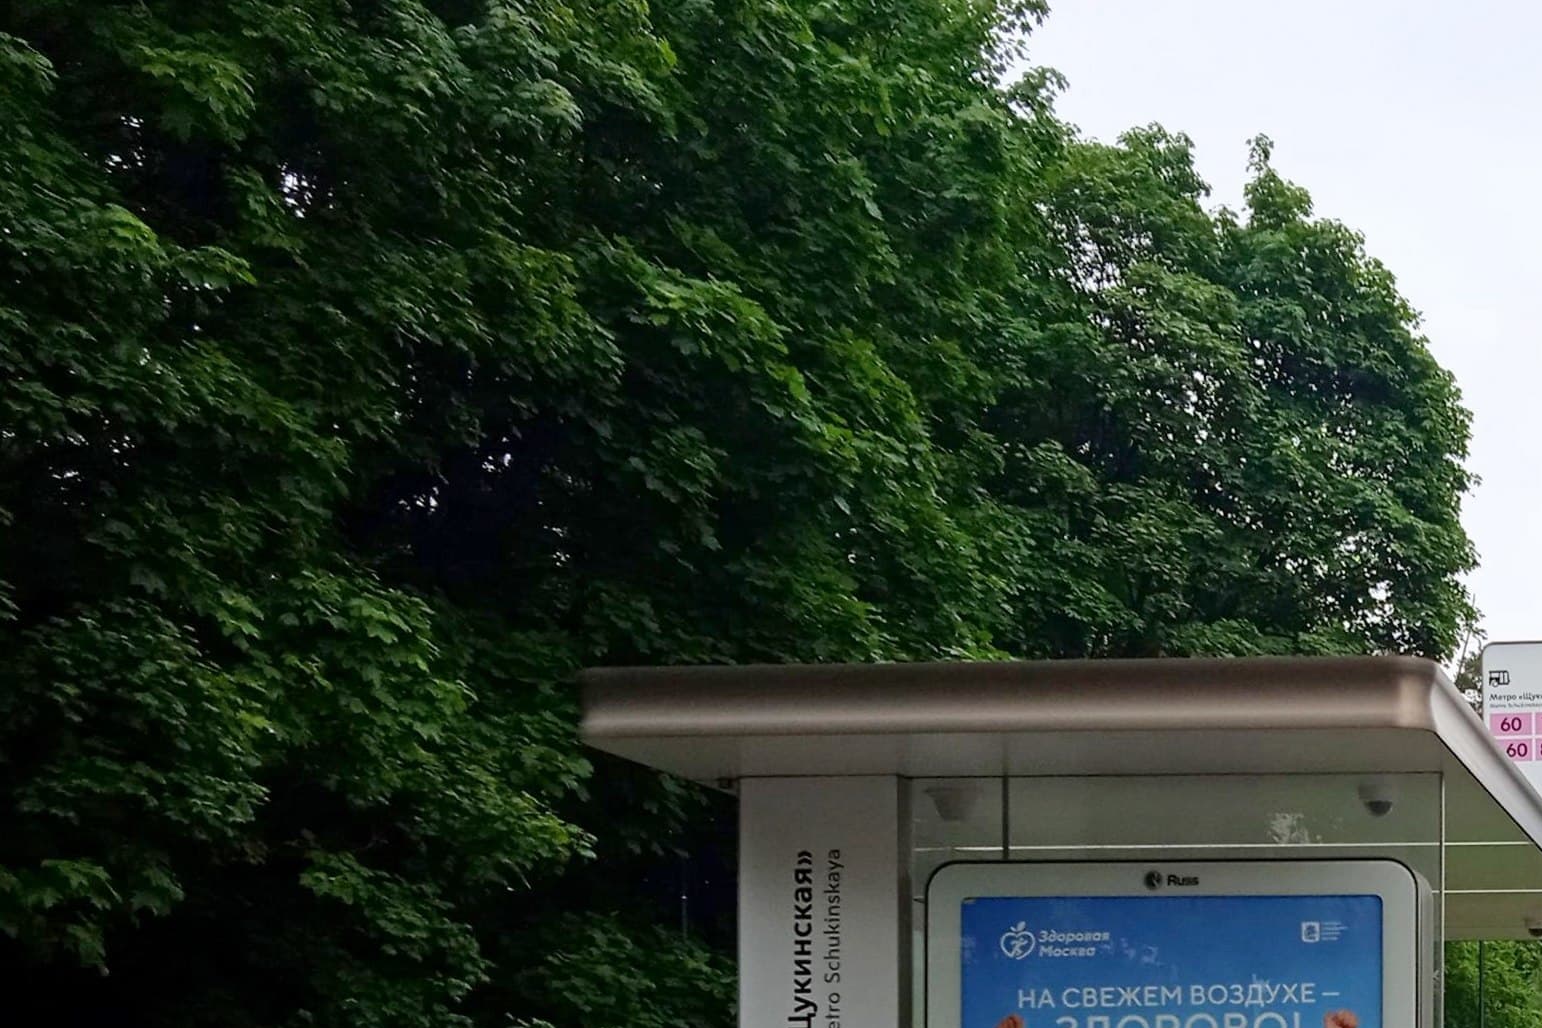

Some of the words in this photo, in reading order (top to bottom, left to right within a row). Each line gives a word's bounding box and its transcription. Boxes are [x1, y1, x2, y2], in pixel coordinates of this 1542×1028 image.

[1489, 693, 1517, 701] Метро
[1500, 717, 1522, 731] 60
[1167, 875, 1199, 886] Russ
[823, 848, 844, 983] Schukinskaya
[1038, 929, 1110, 944] Здоровая
[1039, 946, 1096, 957] Москва
[1018, 989, 1055, 1009] НА
[1062, 986, 1182, 1008] СВЕЖЕМ
[1190, 983, 1316, 1008] ВОЗДУХЕ
